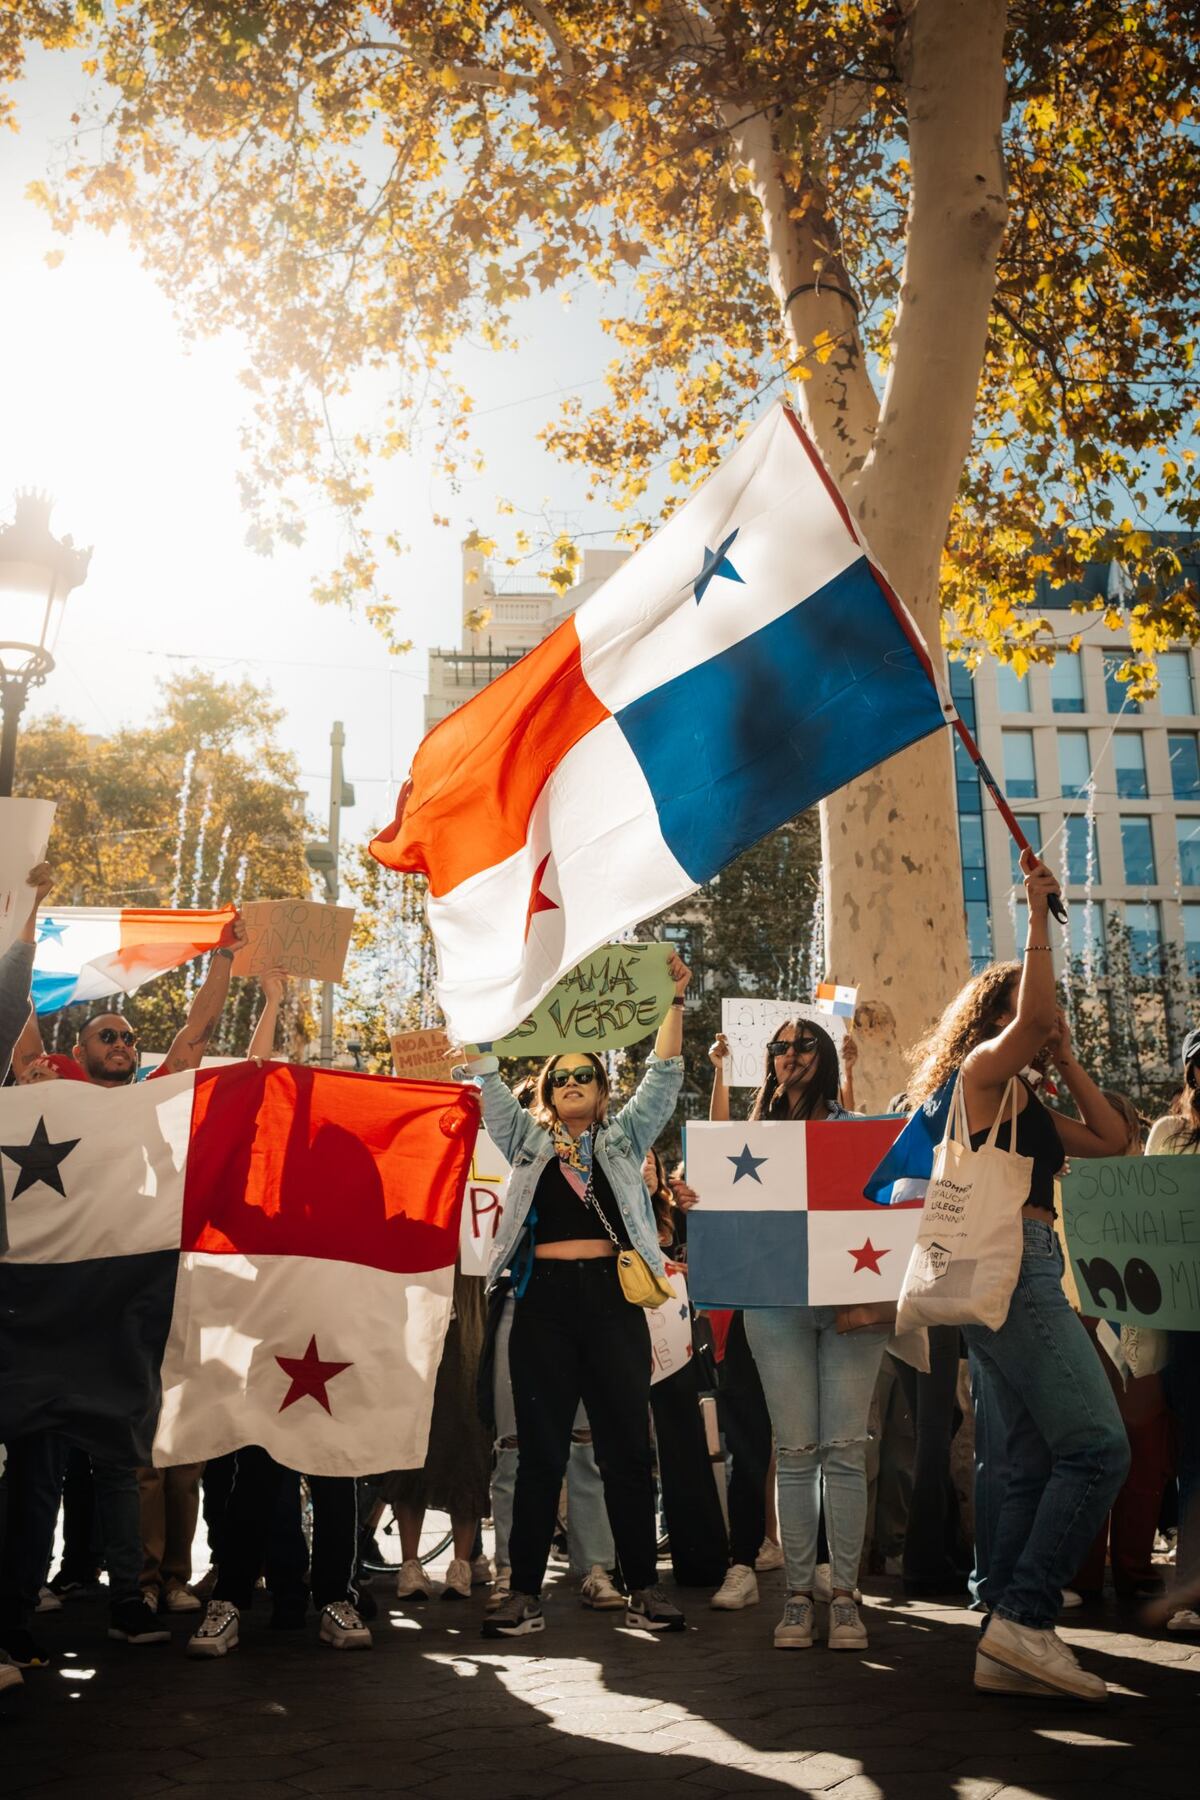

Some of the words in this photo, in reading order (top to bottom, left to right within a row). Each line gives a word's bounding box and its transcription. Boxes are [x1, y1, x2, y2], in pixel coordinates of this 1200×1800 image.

[271, 904, 309, 925] ORO
[548, 995, 660, 1039] VERDE
[727, 1001, 755, 1027] La
[1078, 1162, 1179, 1200] SOMOS
